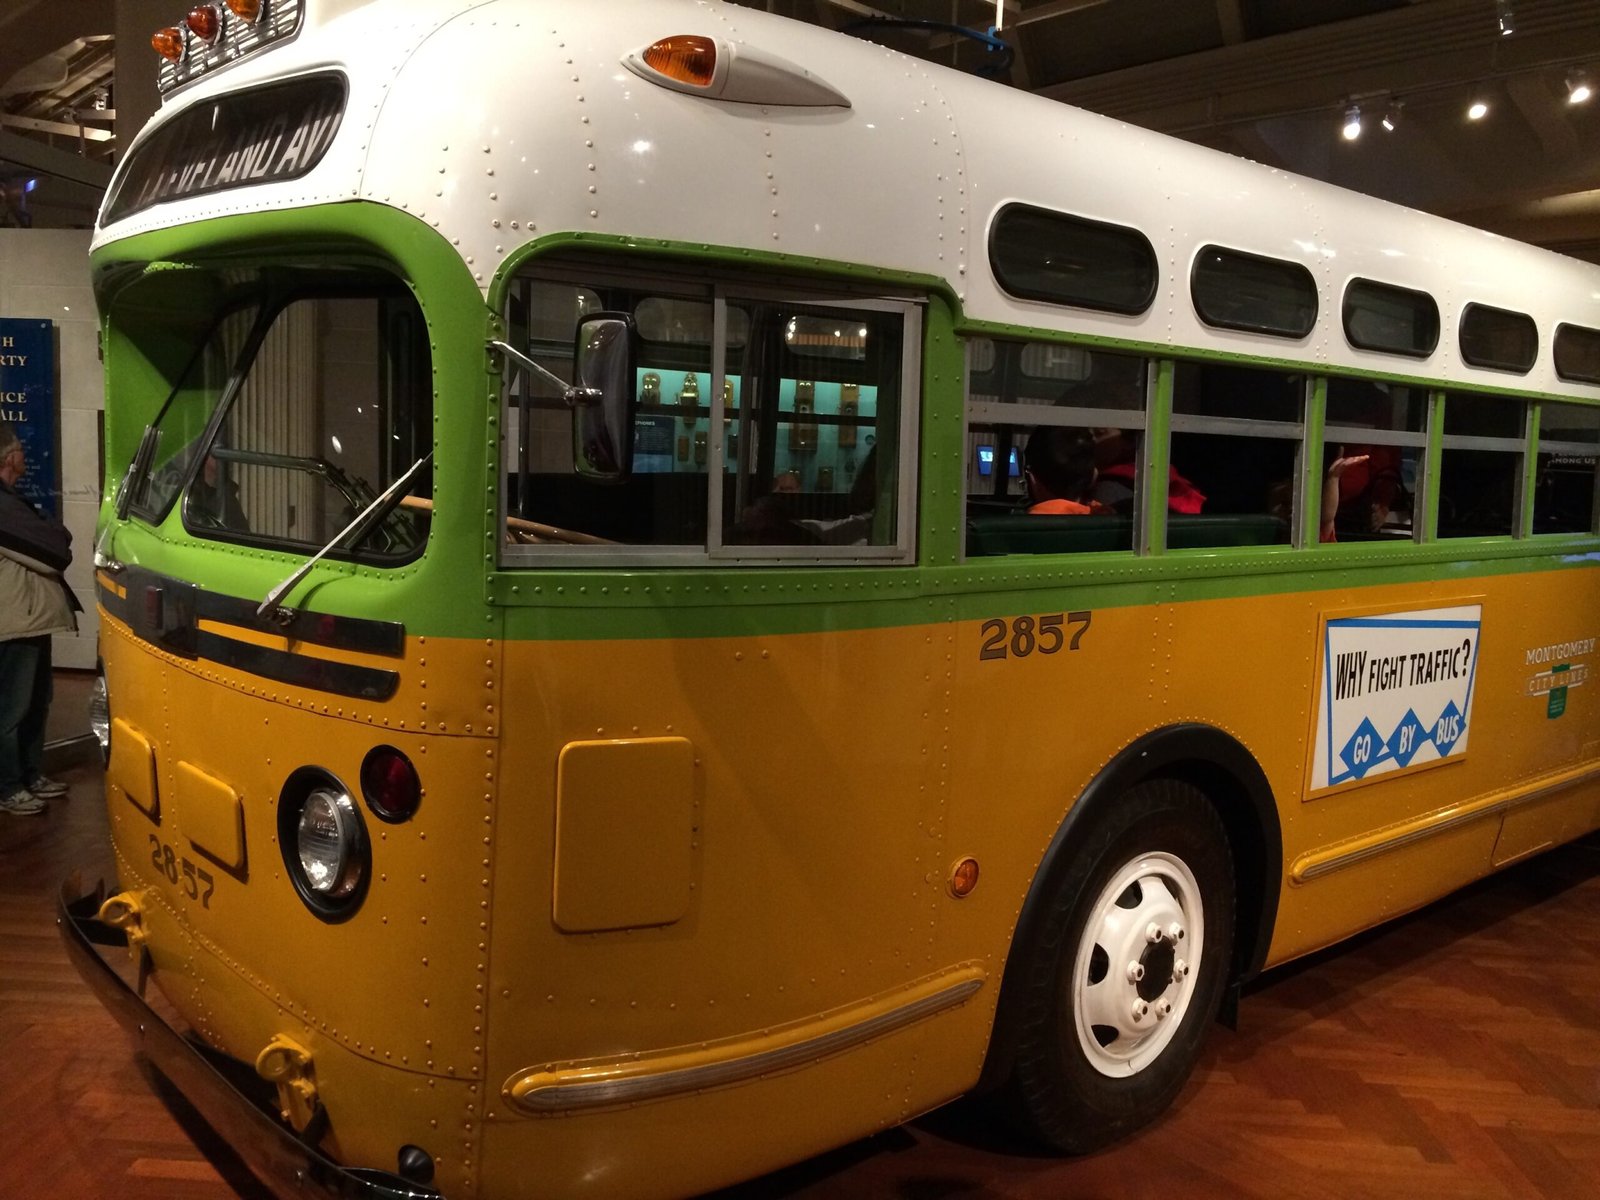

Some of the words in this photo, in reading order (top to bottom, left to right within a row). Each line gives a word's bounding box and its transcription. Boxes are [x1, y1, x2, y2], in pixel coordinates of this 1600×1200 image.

[980, 611, 1091, 660] 2857
[1525, 638, 1596, 665] MONTGOMERY
[1335, 650, 1367, 700] WHY
[1368, 655, 1407, 693] FIGHT
[1409, 638, 1471, 686] TRAFFIC?
[1528, 676, 1556, 691] CITY
[1353, 734, 1371, 765] GO
[1399, 724, 1417, 755] BY
[1436, 714, 1460, 746] BUS
[149, 833, 214, 910] 2857
